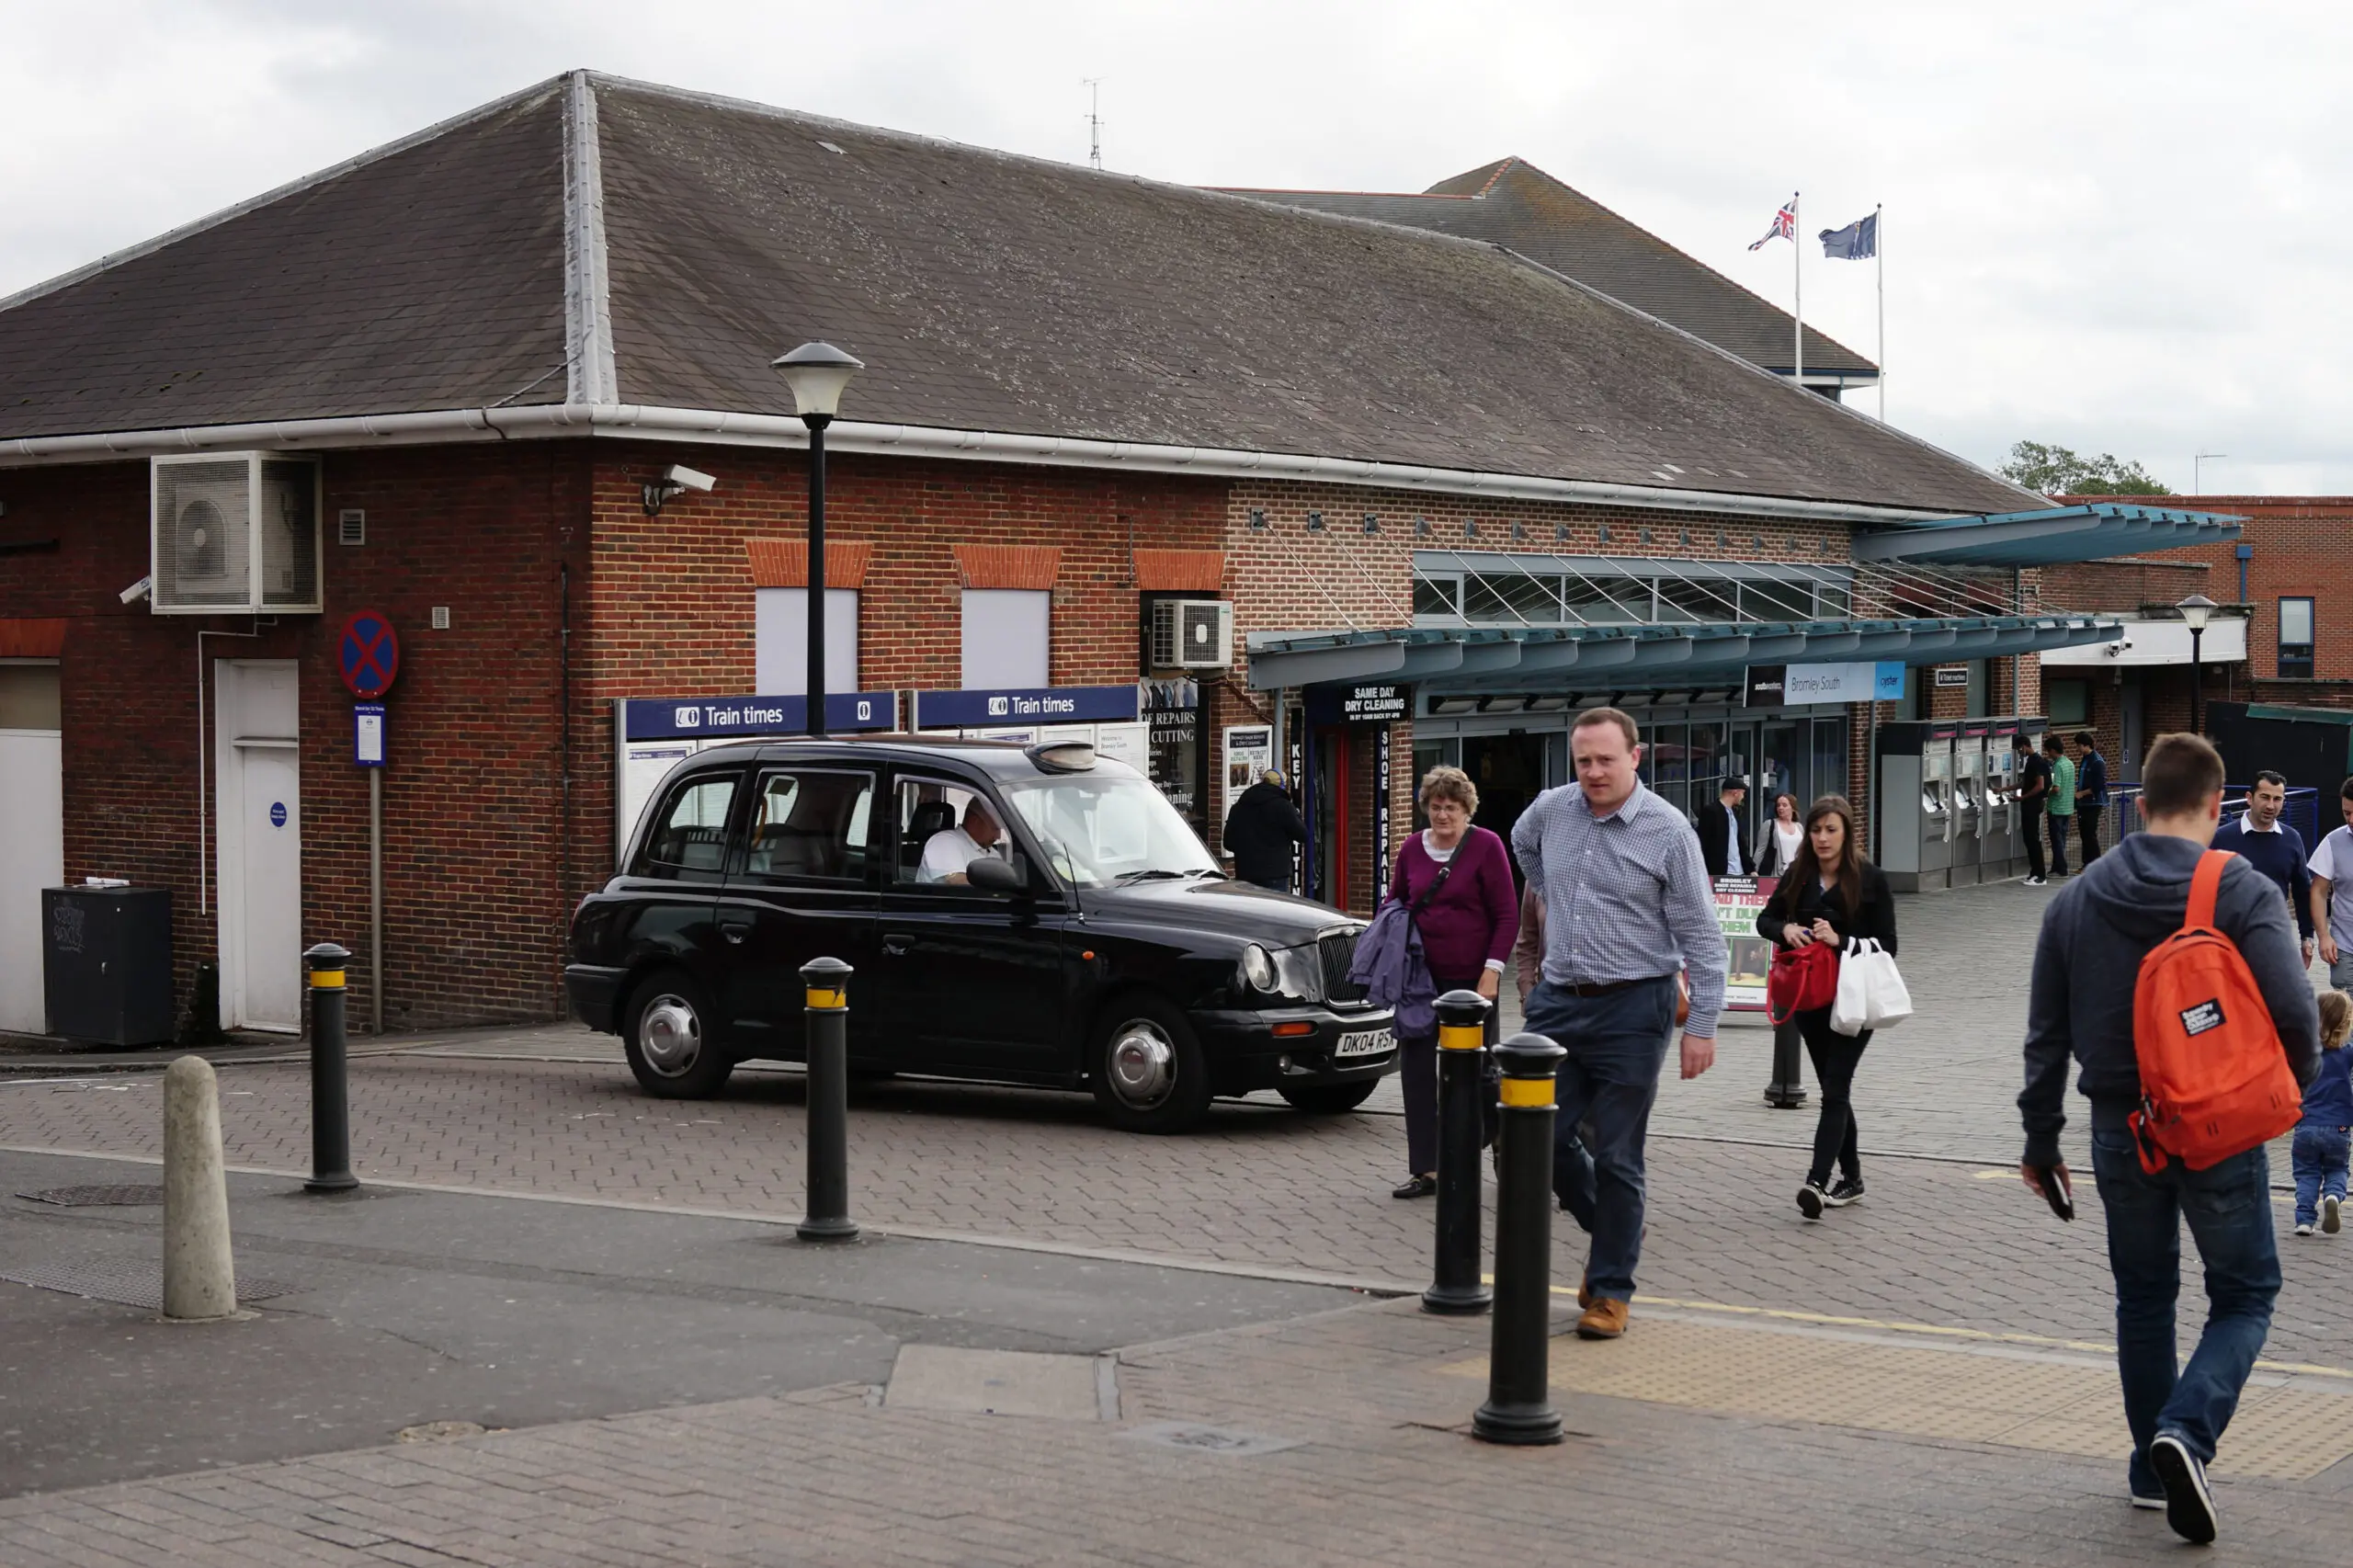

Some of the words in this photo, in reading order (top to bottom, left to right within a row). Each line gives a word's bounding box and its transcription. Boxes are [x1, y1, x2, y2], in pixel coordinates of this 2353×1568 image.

[1791, 677, 1819, 694] Bromley
[1821, 676, 1841, 690] South
[1881, 676, 1899, 687] oyster
[1355, 687, 1378, 699] SAME
[1380, 687, 1395, 698] DAY
[1012, 697, 1040, 713] Train
[1042, 697, 1074, 713] times
[1345, 700, 1362, 711] DRY
[1364, 699, 1404, 710] CLEANING
[705, 706, 740, 725] Train
[743, 706, 783, 724] times
[1142, 713, 1154, 725] OE
[1156, 712, 1195, 725] REPAIRS
[1151, 730, 1194, 743] CUTTING
[1292, 744, 1301, 789] KEY
[1342, 1033, 1375, 1052] DK04
